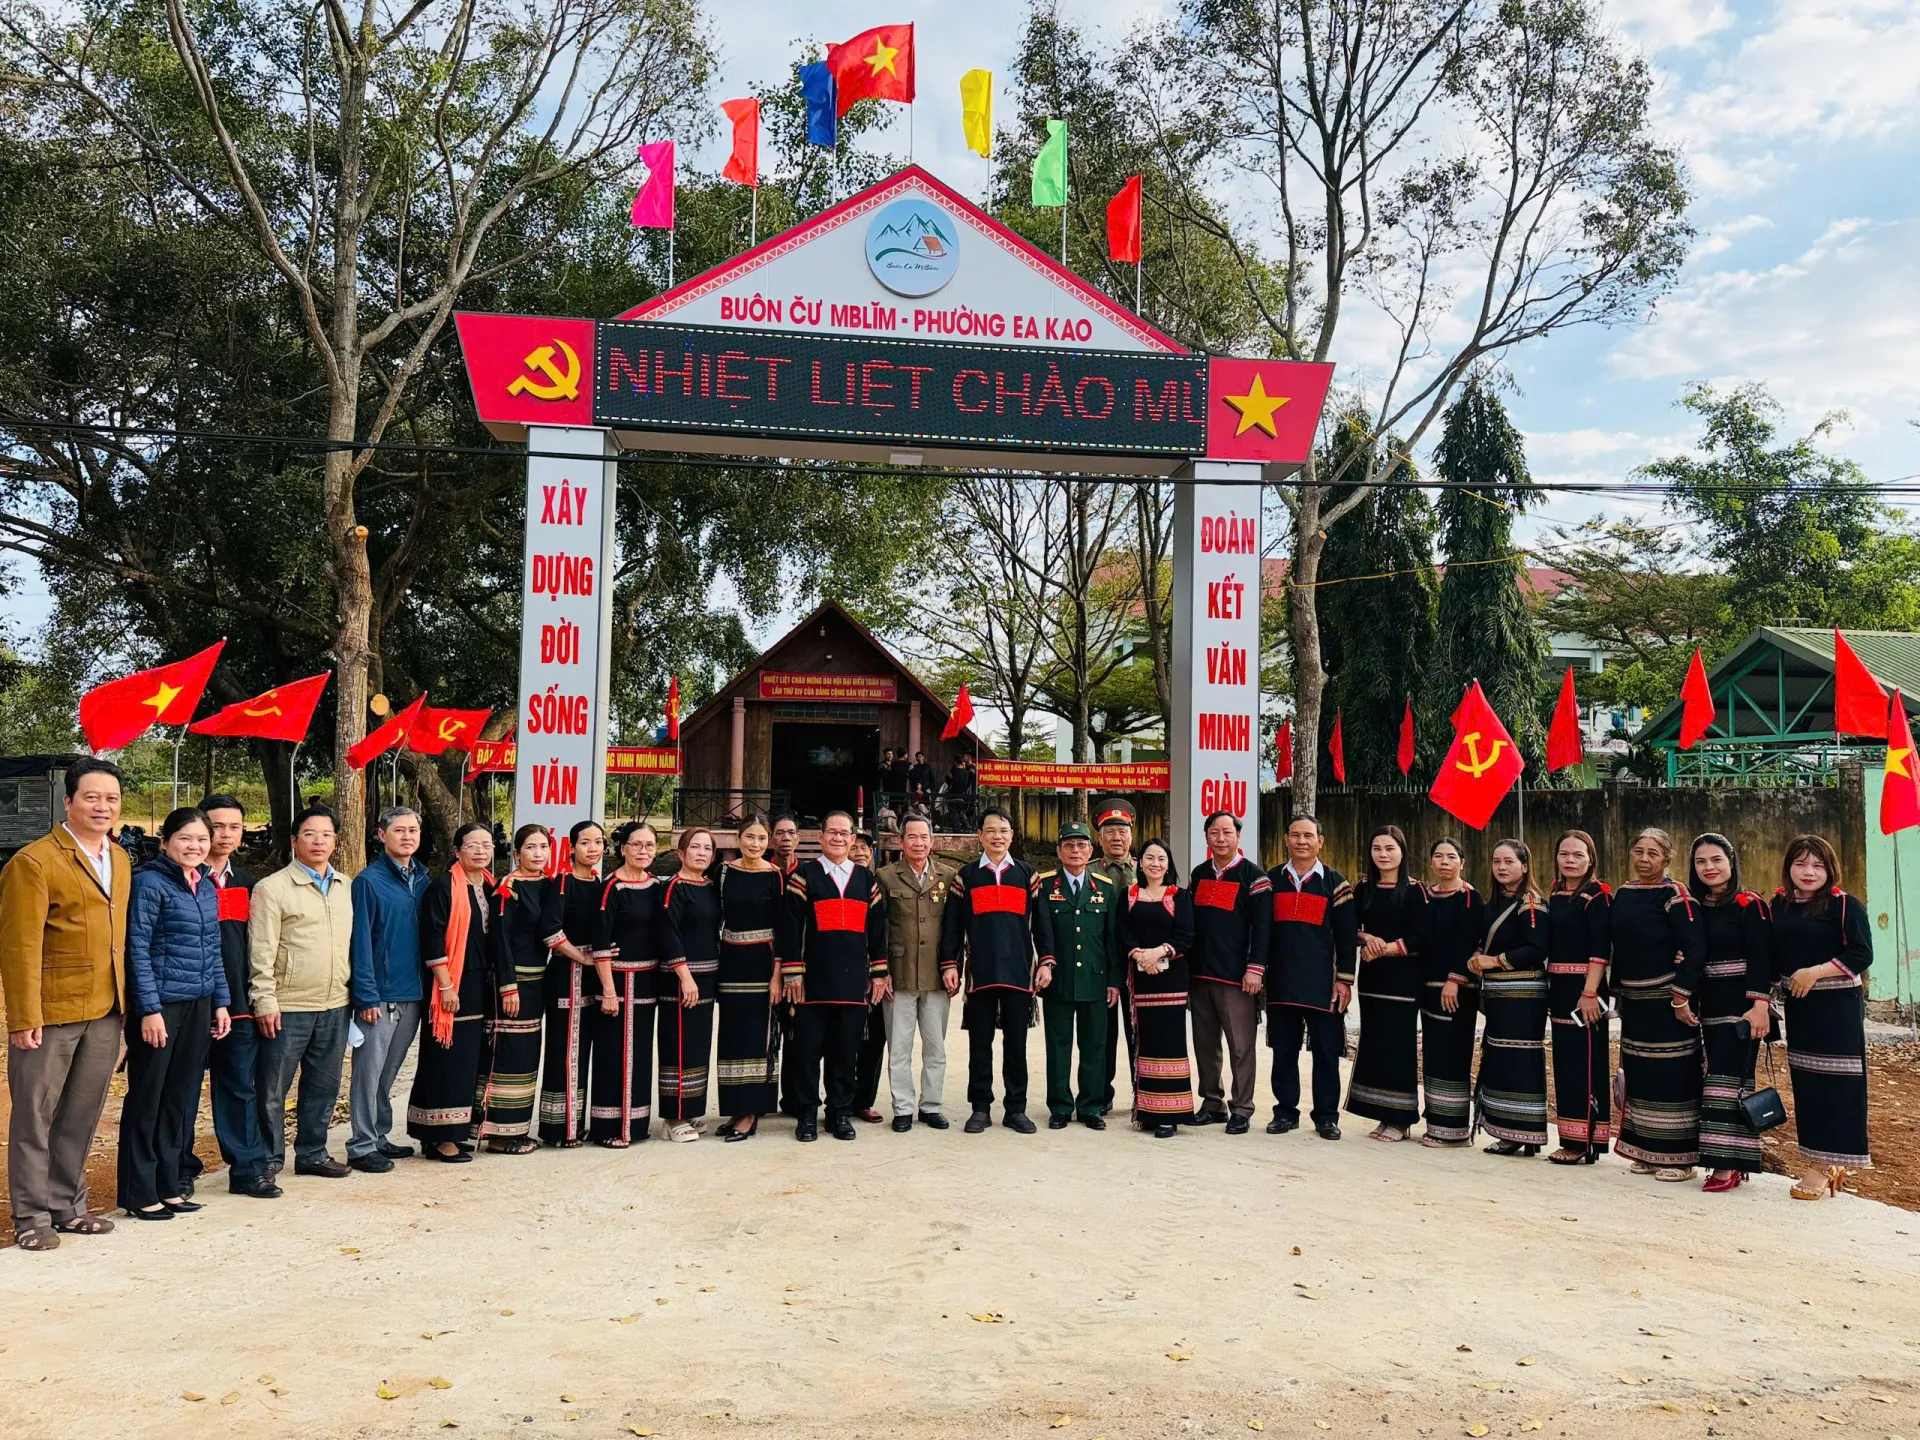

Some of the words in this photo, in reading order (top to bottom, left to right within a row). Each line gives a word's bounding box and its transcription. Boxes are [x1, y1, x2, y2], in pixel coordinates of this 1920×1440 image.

[720, 293, 782, 323] BUÔN
[789, 295, 823, 325] ČƯ
[830, 301, 896, 330] MBLĬM
[914, 304, 1005, 337] PHƯỜNG
[1013, 315, 1040, 340] EA
[1045, 317, 1092, 342] KAO
[811, 359, 935, 416] LIỆT
[952, 361, 1115, 420] CHÀO
[540, 478, 588, 526] XÂY
[1200, 510, 1255, 555] ĐOÀN
[532, 551, 594, 602] DỰNG
[1207, 573, 1245, 620] KẾT
[540, 616, 580, 665] ĐỜI
[1206, 640, 1246, 686] VĂN
[527, 683, 588, 736] SỐNG
[1198, 713, 1250, 752] MINH
[532, 757, 579, 806] VĂN
[616, 752, 634, 768] VINH
[636, 751, 658, 768] MUÔN
[658, 752, 676, 769] NĂM
[1010, 774, 1022, 782] KAO
[1056, 765, 1068, 773] KAO
[1136, 765, 1149, 774] XÂY
[1200, 772, 1247, 818] GIÀU
[543, 827, 574, 877] ÓA
